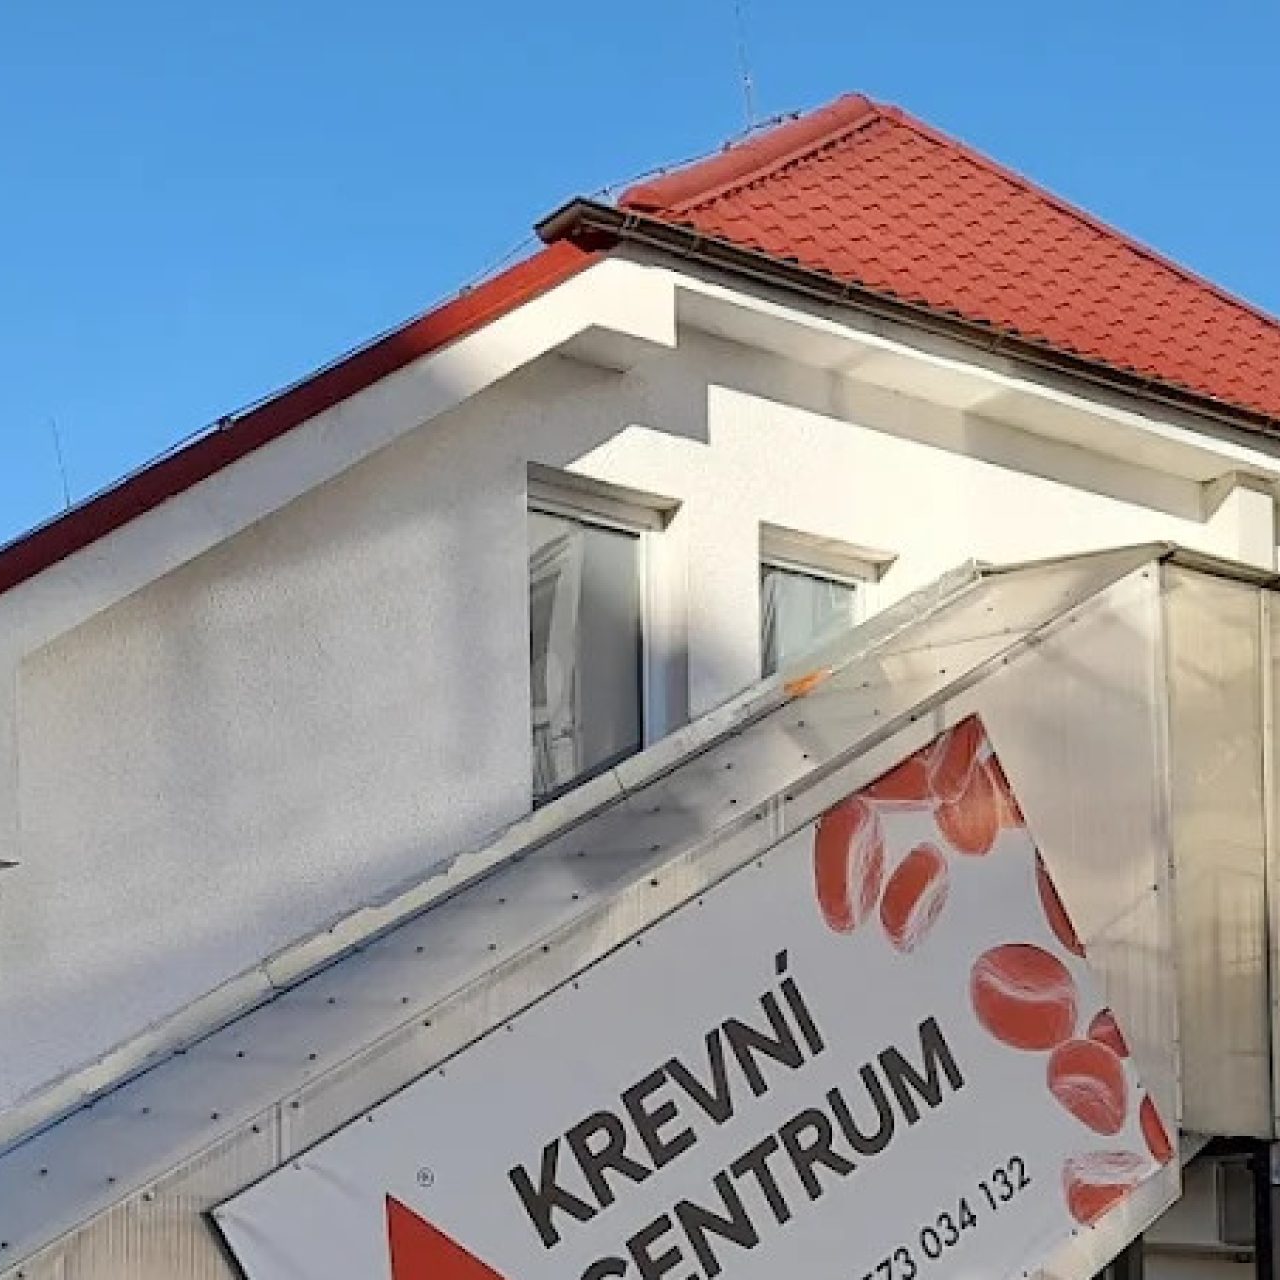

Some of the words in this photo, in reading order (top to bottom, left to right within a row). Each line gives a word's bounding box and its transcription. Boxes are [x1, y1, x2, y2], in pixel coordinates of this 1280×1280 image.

[506, 948, 826, 1250] KREVNÍ
[919, 1197, 977, 1261] 034
[978, 1155, 1031, 1211] 132
